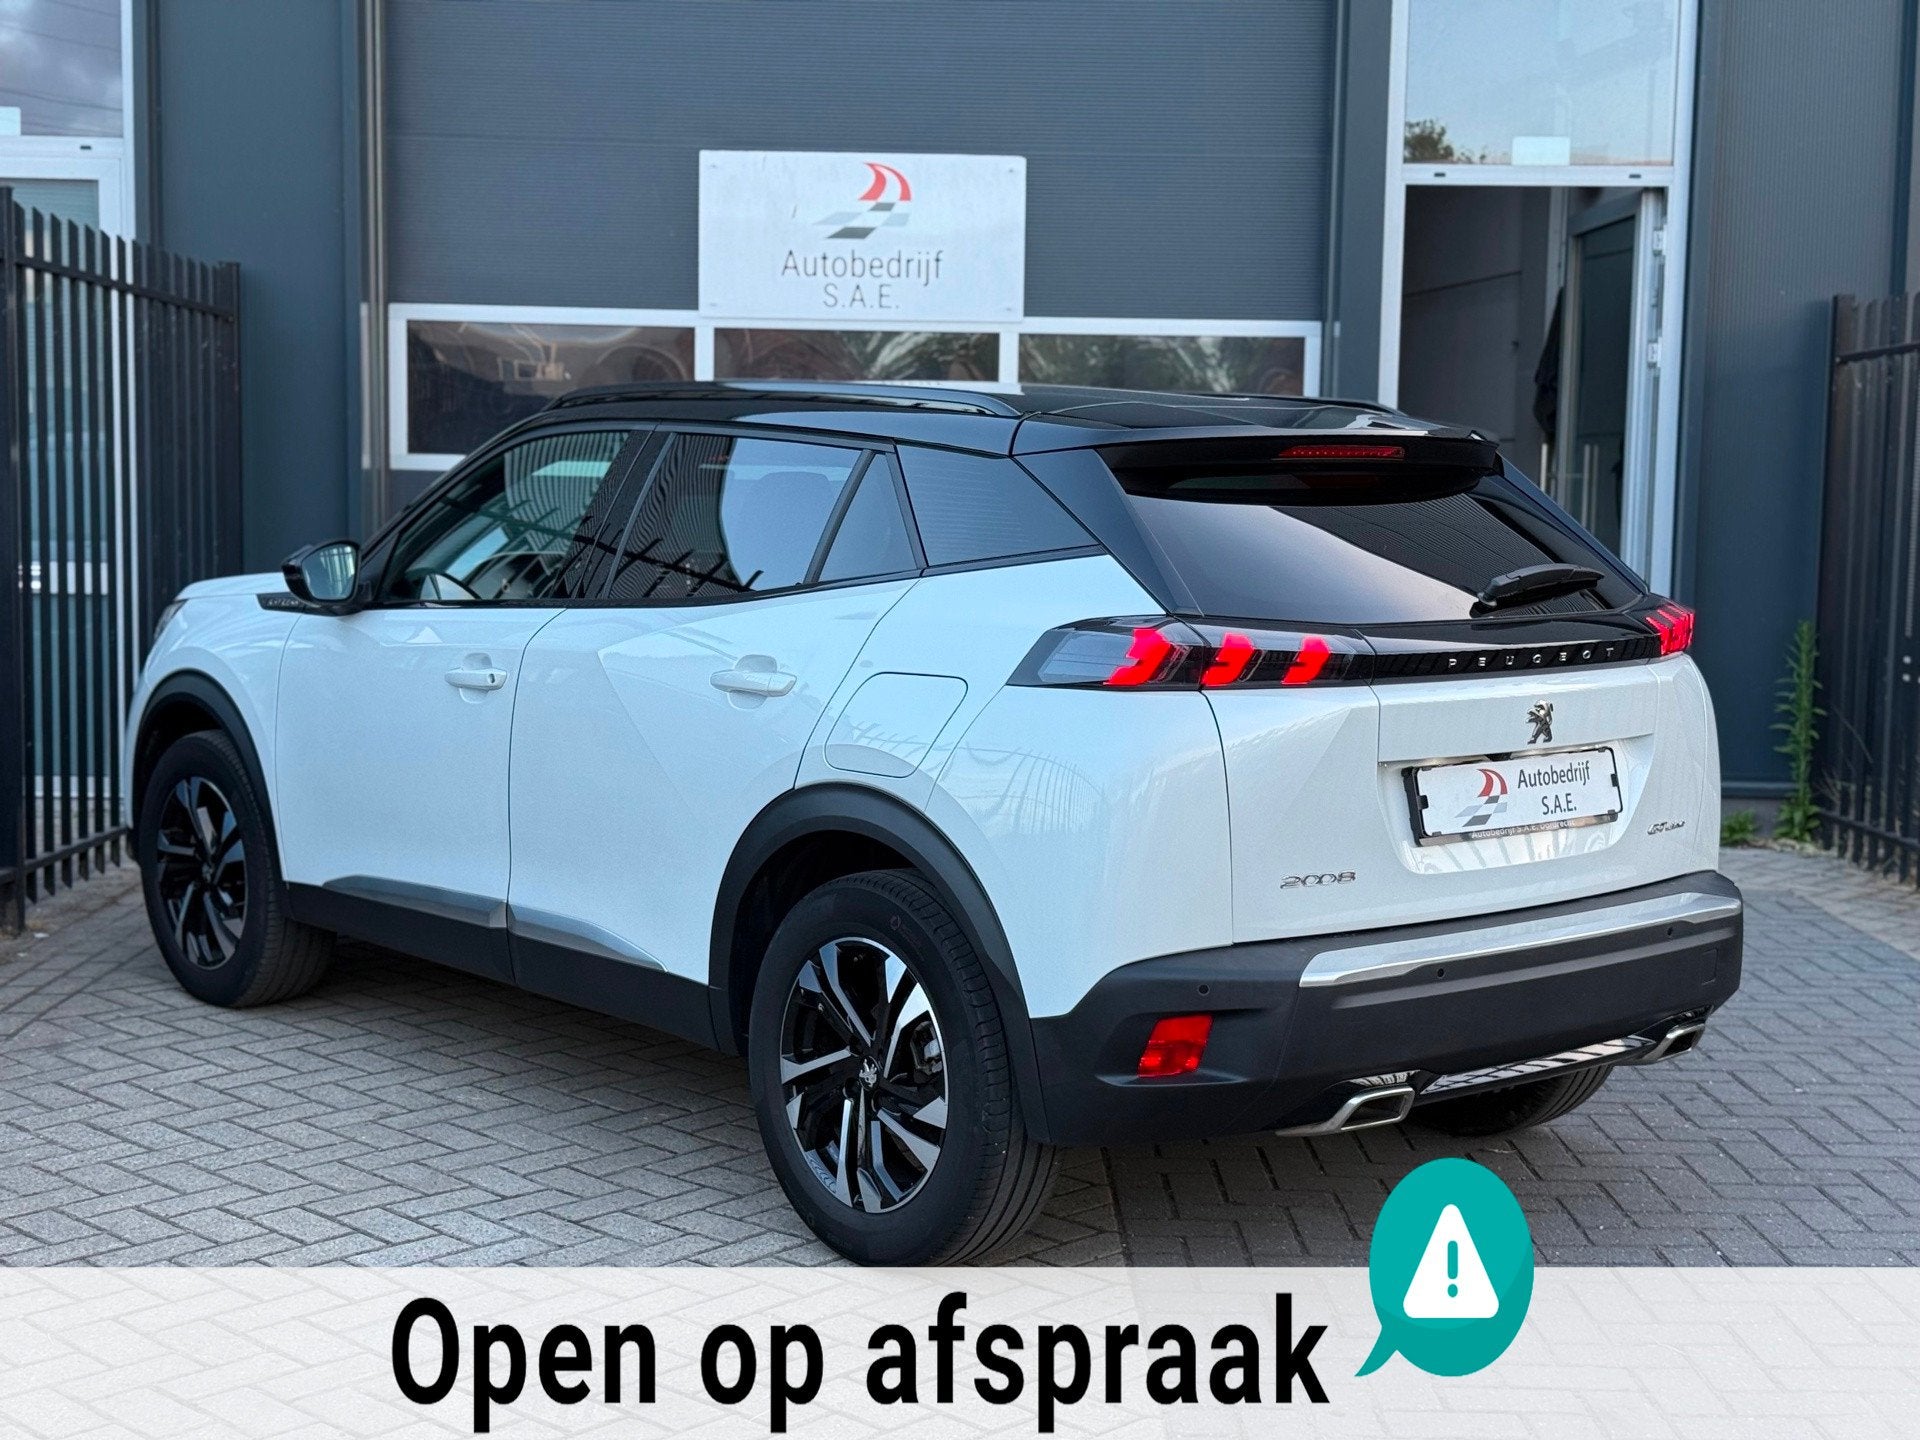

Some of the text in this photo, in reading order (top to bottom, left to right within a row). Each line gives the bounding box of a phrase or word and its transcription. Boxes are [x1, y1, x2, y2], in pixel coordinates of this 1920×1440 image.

[781, 249, 943, 287] Autobedrijf
[823, 282, 899, 309] S.A.E.
[1448, 647, 1614, 669] PEUGEOT
[1517, 760, 1590, 789] Autobedrijf
[1541, 792, 1577, 816] S.A.E.
[1280, 871, 1356, 889] 2008
